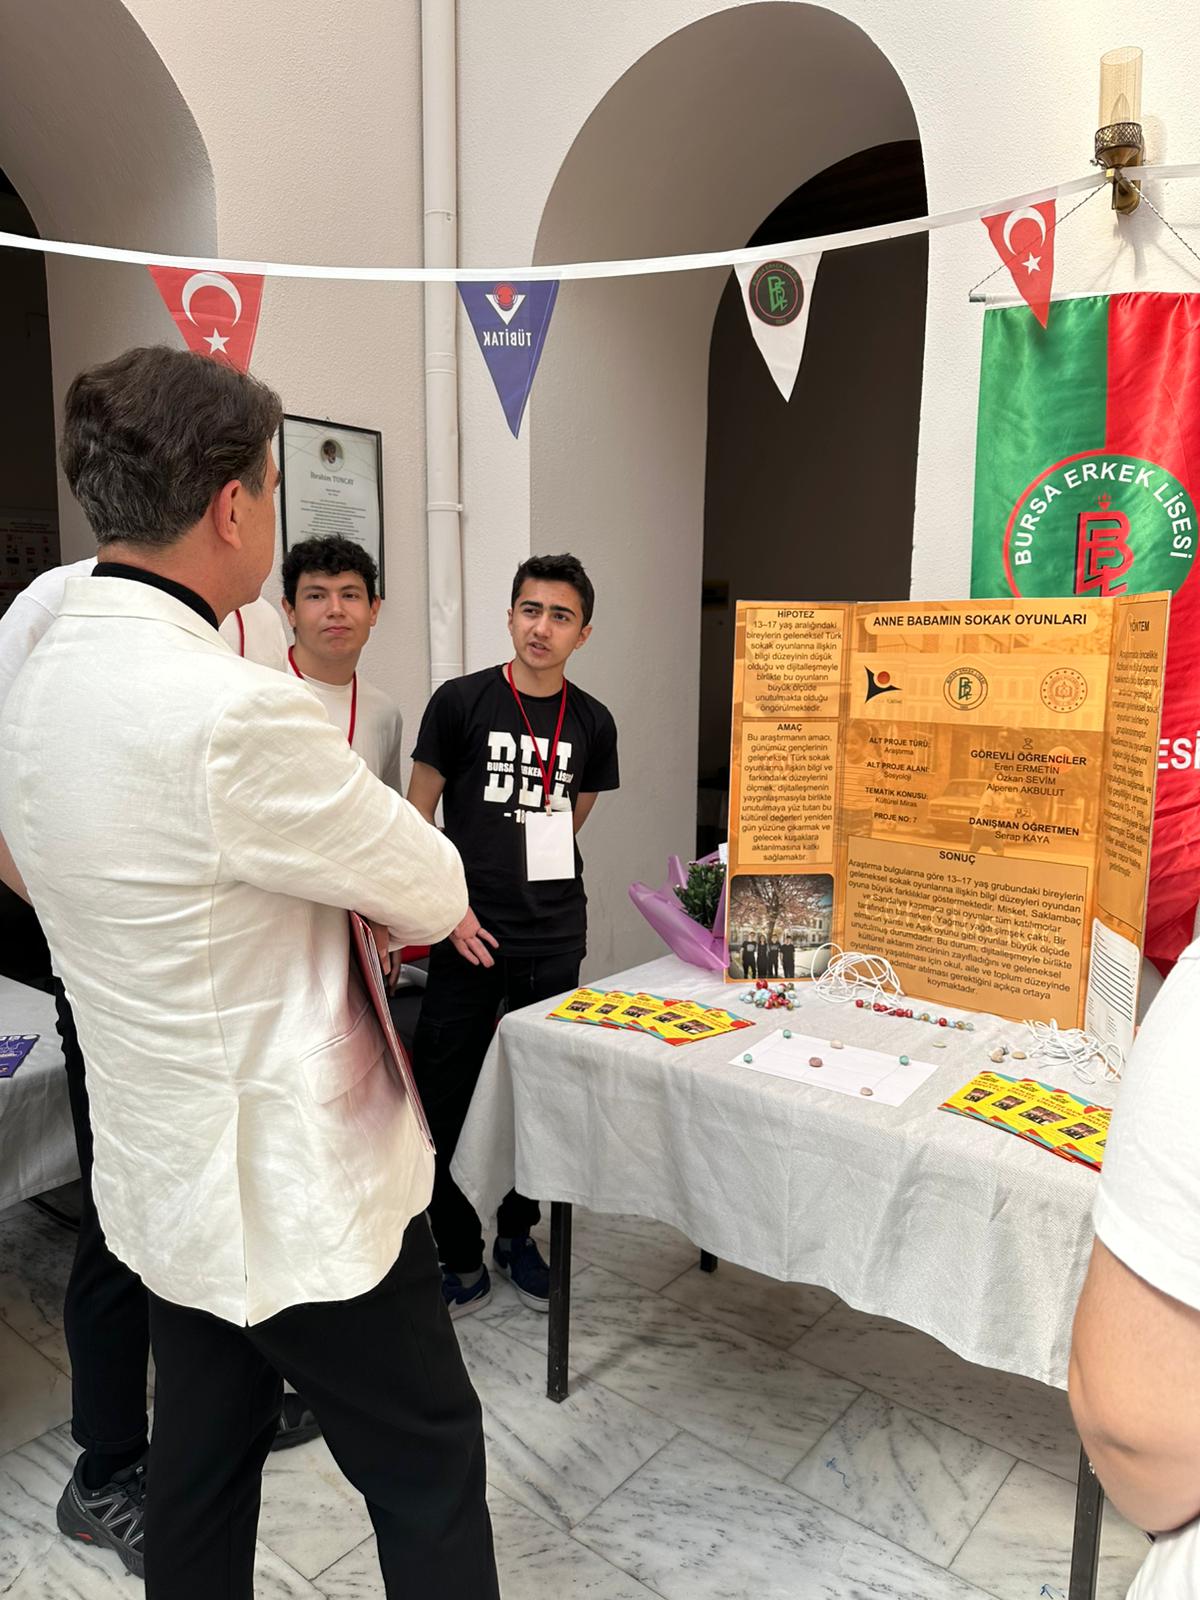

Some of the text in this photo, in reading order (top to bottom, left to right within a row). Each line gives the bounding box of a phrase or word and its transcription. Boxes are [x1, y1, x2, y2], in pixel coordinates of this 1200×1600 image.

[1015, 462, 1193, 566] BURSA ERKEK LİSESİ
[778, 610, 814, 618] HİPOTEZ
[873, 614, 1087, 626] ANNE BABAMIN SOKAK OYUNLARI
[795, 622, 837, 630] aralığındaki
[747, 632, 781, 640] bireylerin
[783, 632, 823, 640] geleneksel
[817, 642, 837, 651] ilişkin
[755, 653, 832, 661] bilgi düzeyinin düşük
[748, 663, 773, 671] olduğu
[787, 664, 838, 672] dijitalleşmeyle
[777, 724, 802, 732] AMAÇ
[751, 744, 828, 752] günümüz gençlerinin
[884, 738, 907, 746] PROJE
[909, 739, 930, 748] TÜRÜ:
[971, 749, 1087, 765] GÖREVLİ ÖĞRENCİLER
[486, 762, 514, 773] BURSA
[808, 764, 822, 773] bilgi
[881, 762, 904, 770] PROJE
[994, 763, 1060, 774] Eren ERMETİN
[884, 771, 912, 782] Sosyoloji
[996, 773, 1056, 785] Özkan SEVİM
[987, 784, 1064, 797] Alperen AKBULUT
[770, 814, 802, 822] değerleri
[804, 814, 832, 822] yeniden
[874, 812, 896, 820] PROJE
[742, 824, 756, 832] gün
[758, 824, 785, 832] yüzüne
[969, 817, 1079, 836] DANIŞMAN ÖĞRETMEN
[753, 834, 782, 842] gelecek
[995, 831, 1050, 844] Serap KAYA
[939, 850, 976, 865] SONUÇ
[848, 859, 882, 871] Araştırma
[927, 872, 944, 881] göre
[974, 880, 988, 889] yaş
[991, 883, 1040, 895] grubundaki
[1043, 887, 1084, 902] bireylerin
[850, 870, 1081, 913] geleneksel sokak oyunlarına ilişkin bilgi düzeyleri oyundan
[848, 881, 869, 890] oyuna
[872, 884, 893, 894] büyük
[1031, 909, 1081, 926] Saklambaç
[946, 907, 961, 917] gibi
[936, 913, 968, 928] Yağmur
[994, 925, 1024, 938] şimşek
[1053, 935, 1066, 945] Bir
[934, 927, 959, 938] oyunu
[961, 932, 976, 941] gibi
[978, 935, 1008, 946] oyunlar
[1011, 940, 1037, 951] büyük
[1040, 945, 1070, 958] ölçüde
[858, 932, 885, 943] kültürel
[915, 943, 950, 957] zincirinin
[1013, 963, 1062, 978] geleneksel
[937, 937, 948, 946] Bu
[1043, 957, 1072, 969] birlikte
[928, 955, 942, 966] için
[965, 965, 980, 974] aile
[982, 968, 992, 976] ve
[994, 971, 1022, 983] toplum
[1024, 977, 1070, 992] düzeyinde
[950, 971, 992, 987] gerektiğini
[993, 982, 1020, 994] açıkça
[1022, 987, 1051, 1000] ortaya
